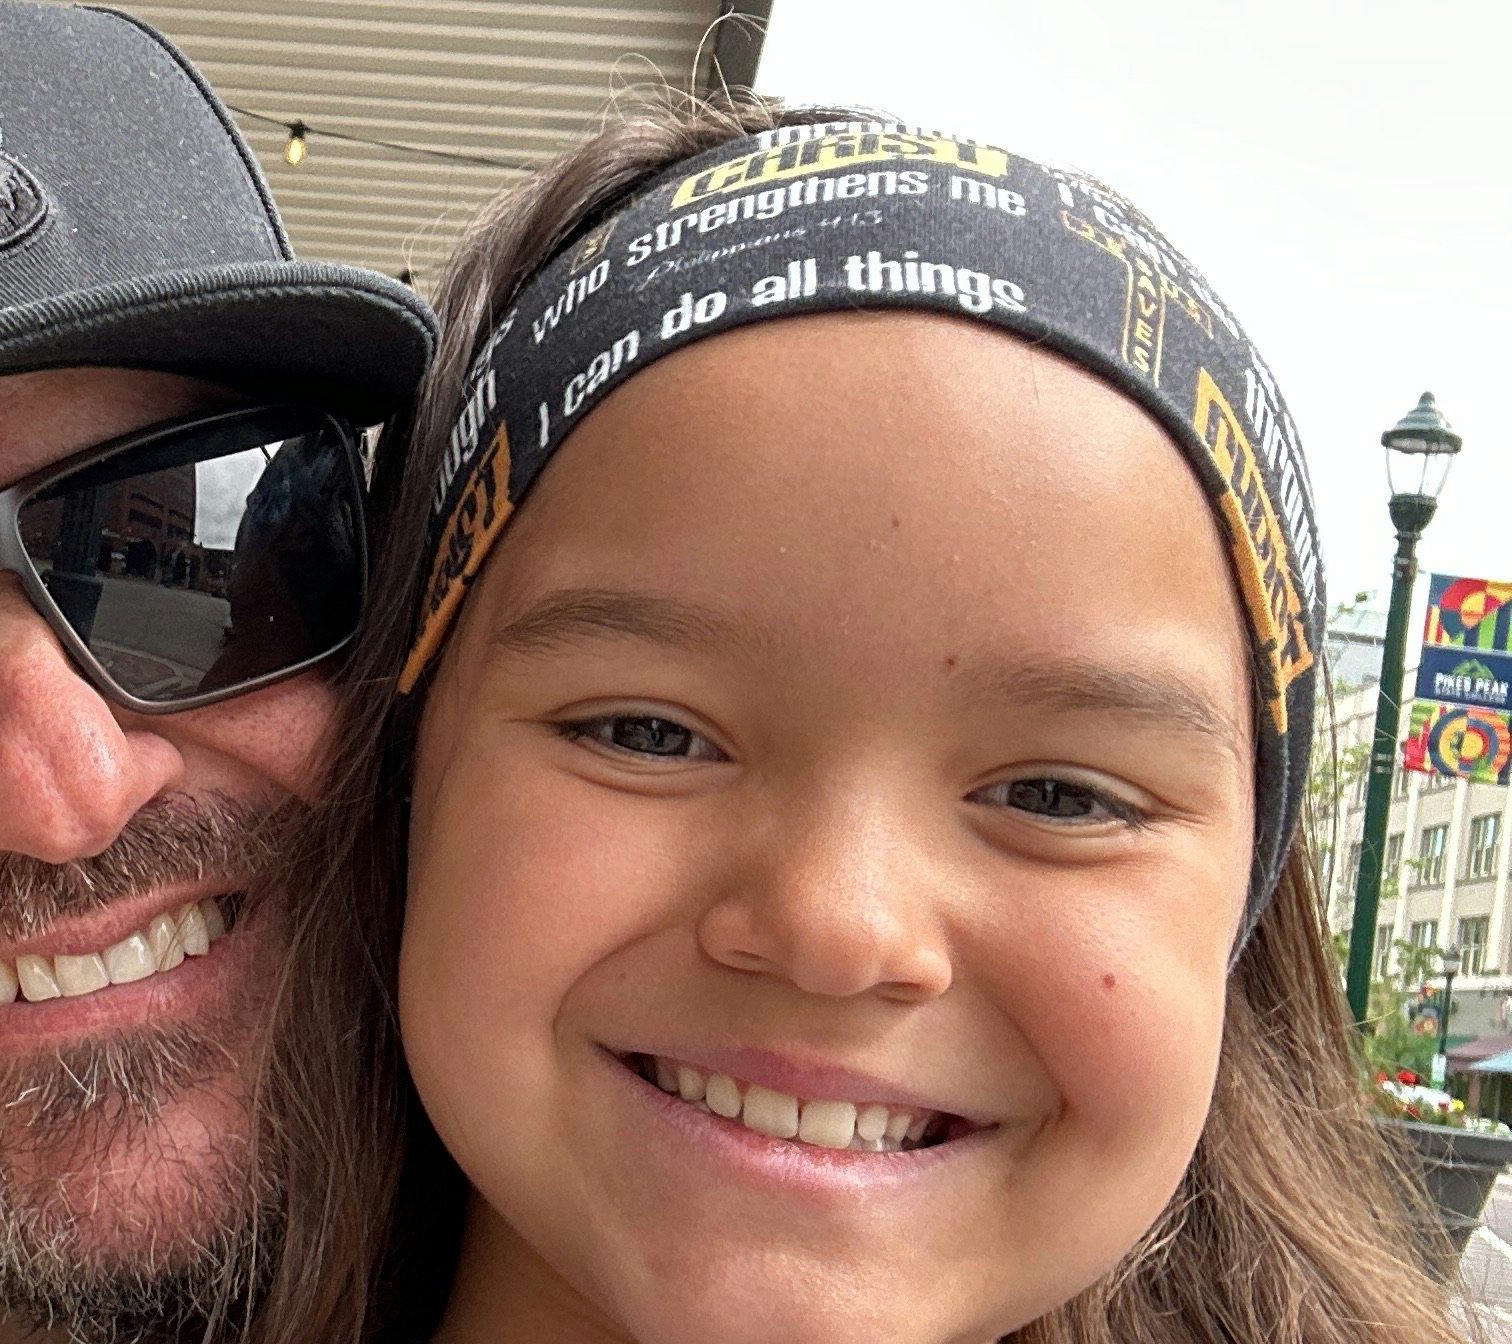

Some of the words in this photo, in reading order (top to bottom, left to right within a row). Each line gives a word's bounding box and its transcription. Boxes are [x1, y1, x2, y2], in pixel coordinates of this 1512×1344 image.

[531, 260, 611, 345] who
[626, 170, 929, 268] strengthens
[950, 175, 1028, 216] me
[538, 400, 550, 449] I
[562, 329, 641, 418] can
[659, 291, 728, 341] do
[750, 257, 817, 307] all
[843, 250, 1028, 314] things
